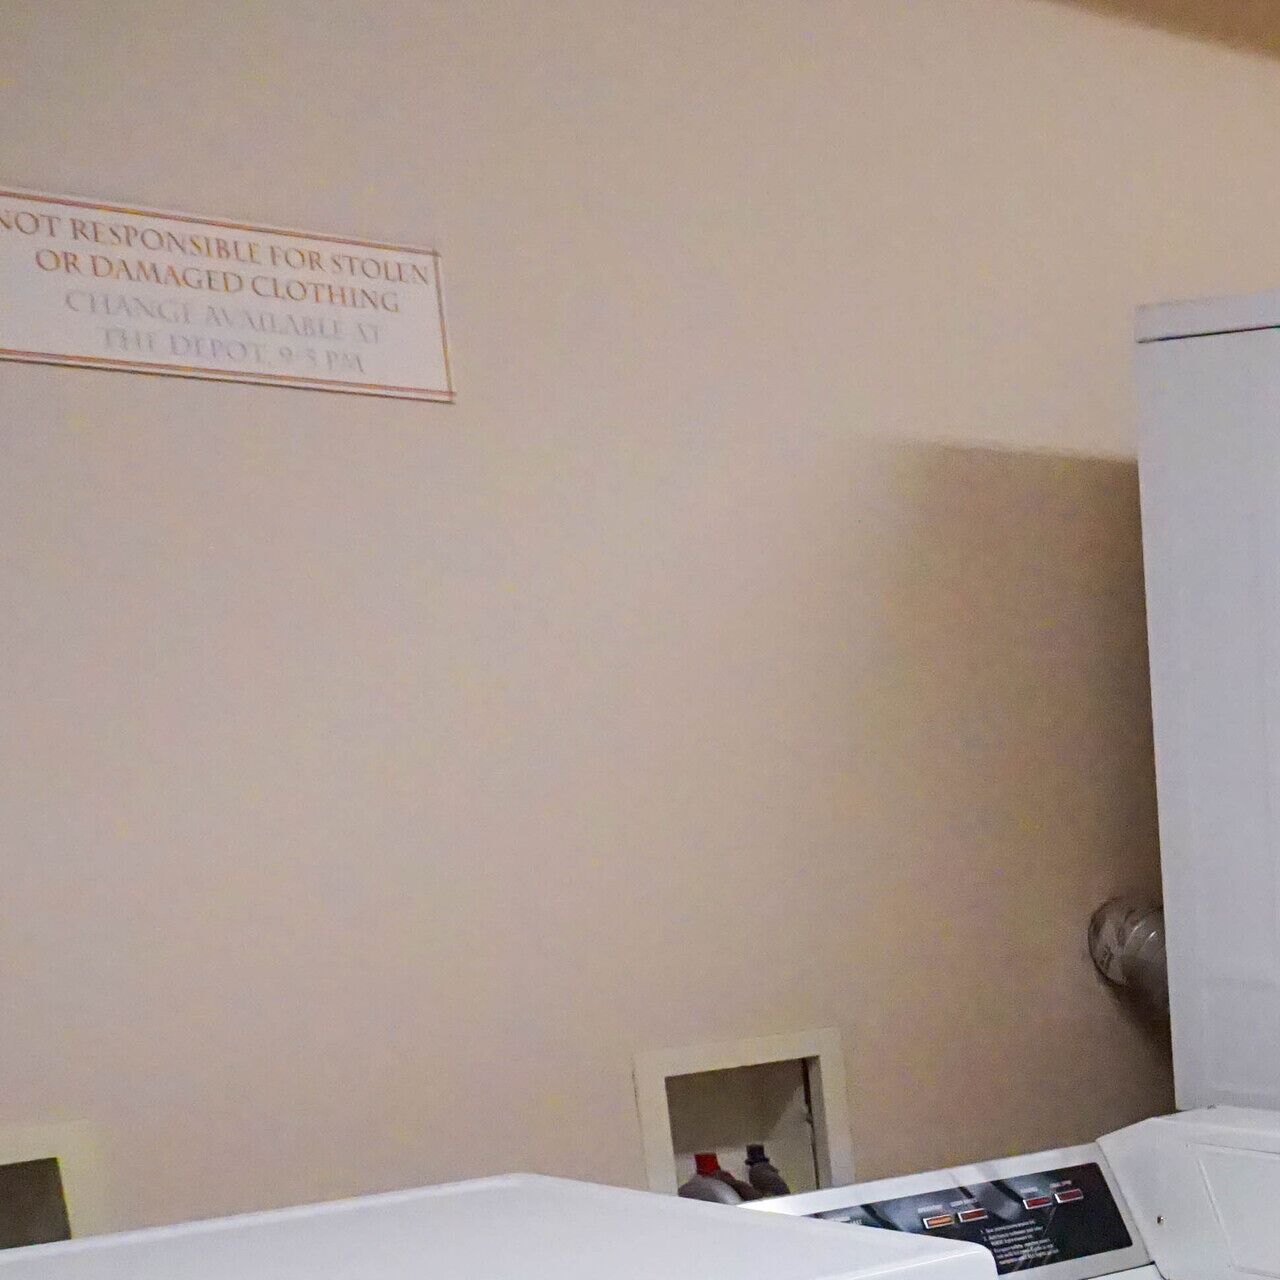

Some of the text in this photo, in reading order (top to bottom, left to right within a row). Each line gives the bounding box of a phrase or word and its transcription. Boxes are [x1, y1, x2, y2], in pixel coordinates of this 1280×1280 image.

[35, 249, 401, 313] OR DAMAGED CLOTHING
[70, 217, 260, 264] RESPONSIBLE
[270, 245, 326, 272] FOR
[330, 253, 431, 285] STOLEN
[65, 289, 191, 324] CHANGE
